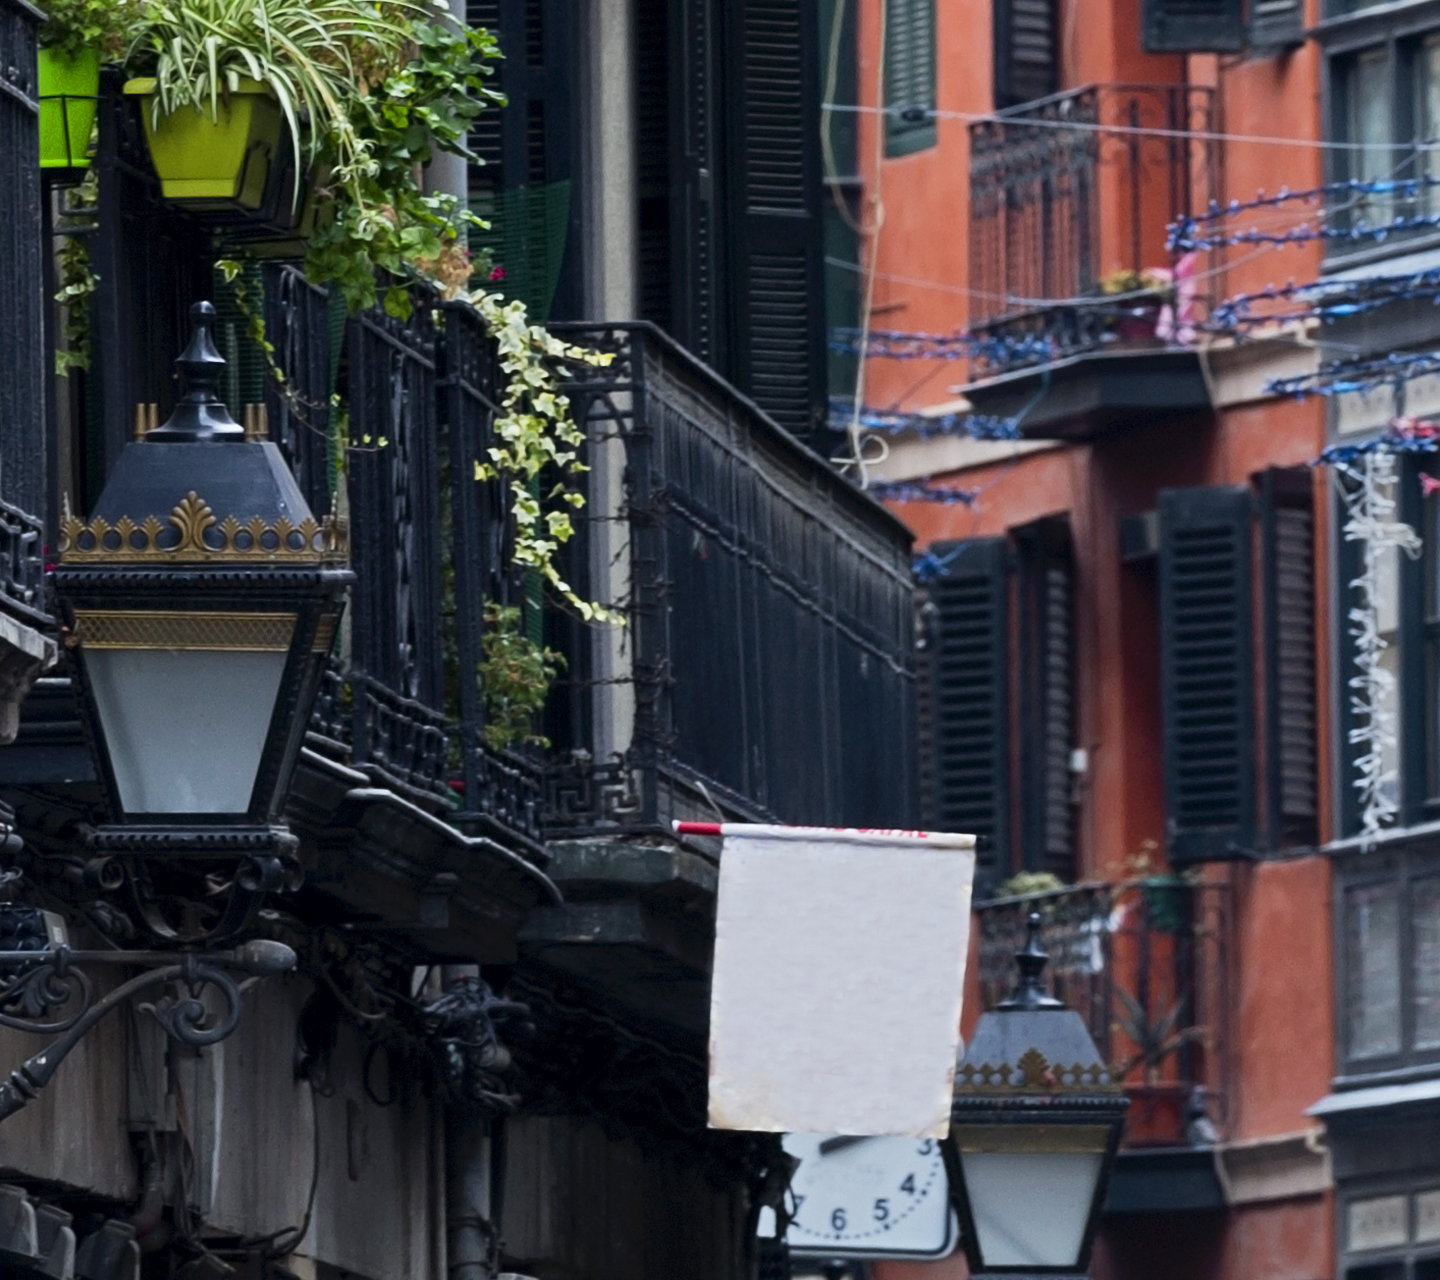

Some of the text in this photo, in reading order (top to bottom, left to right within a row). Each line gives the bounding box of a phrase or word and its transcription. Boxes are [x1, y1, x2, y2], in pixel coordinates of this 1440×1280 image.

[899, 1173, 916, 1195] 4
[831, 1208, 847, 1231] 6
[874, 1198, 890, 1221] 5
